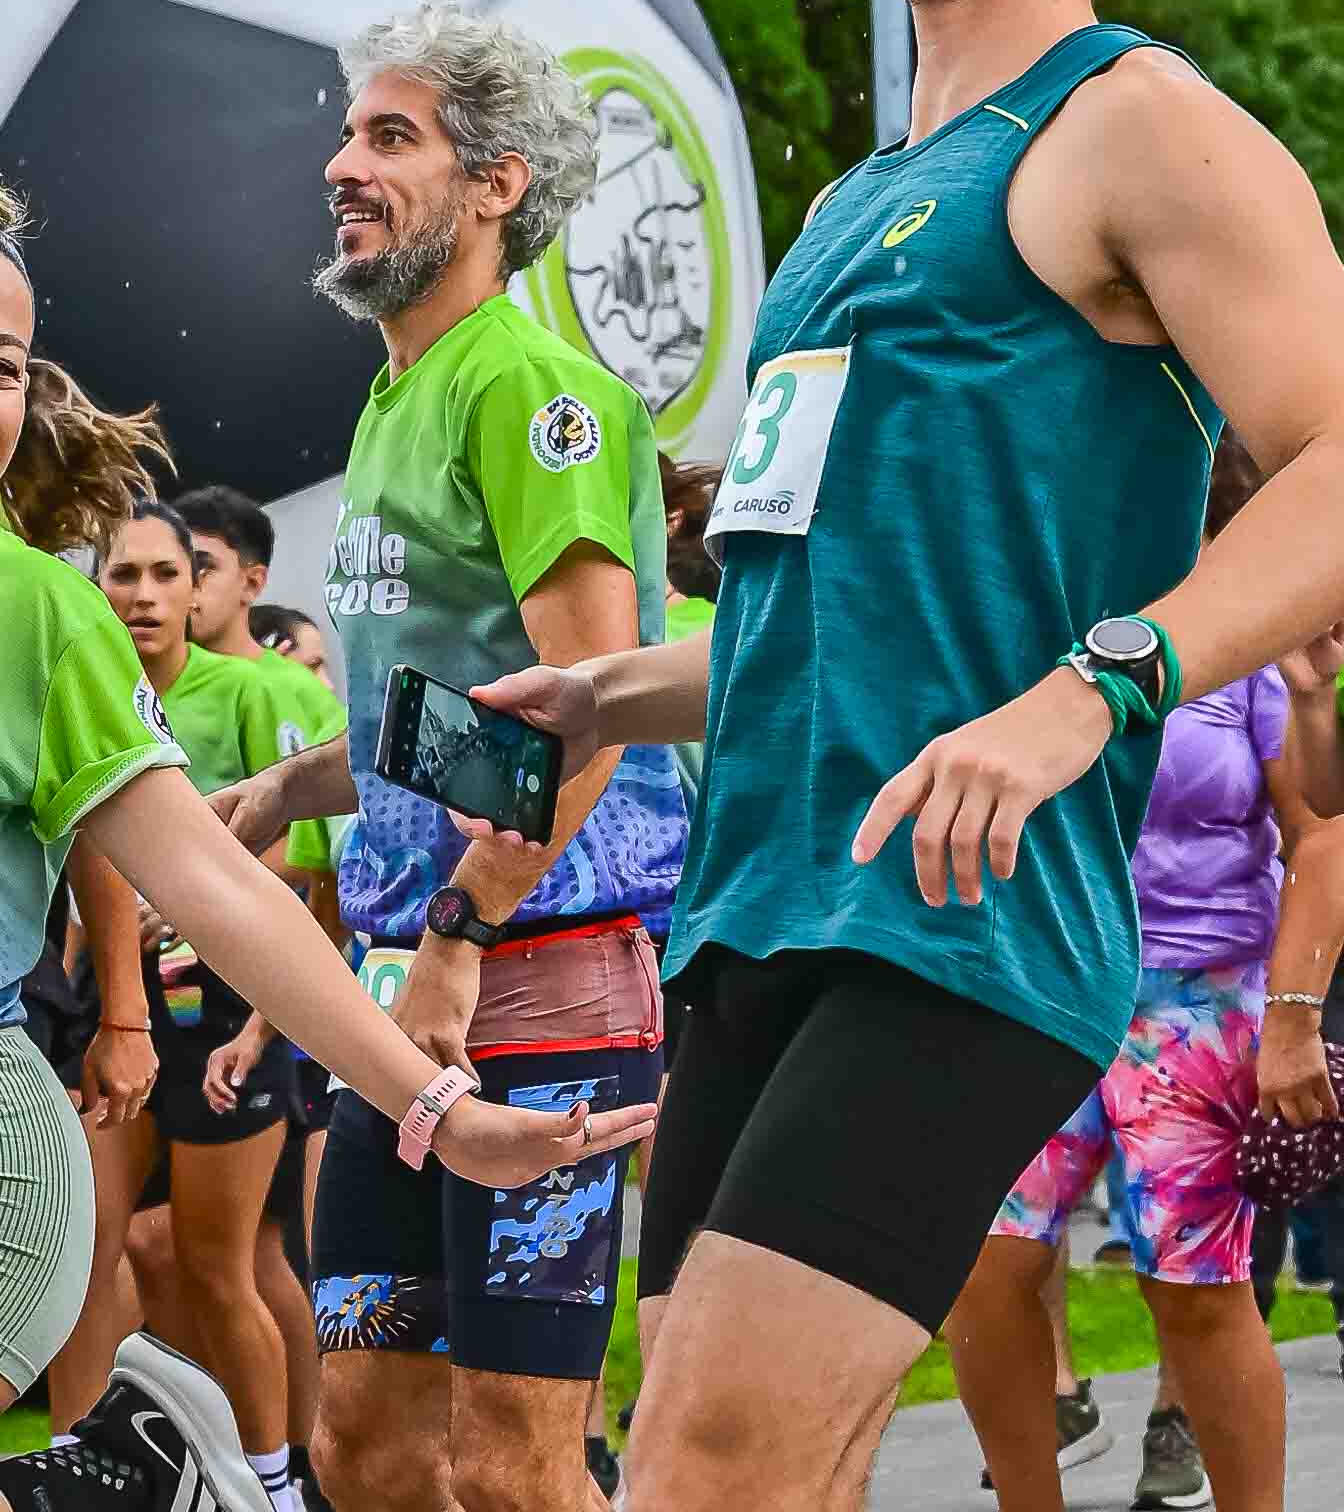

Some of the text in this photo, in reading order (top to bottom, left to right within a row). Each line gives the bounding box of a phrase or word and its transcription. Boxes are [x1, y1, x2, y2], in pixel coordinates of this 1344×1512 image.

[724, 371, 798, 485] 3
[733, 499, 792, 515] CARUSO
[358, 963, 406, 1008] 0
